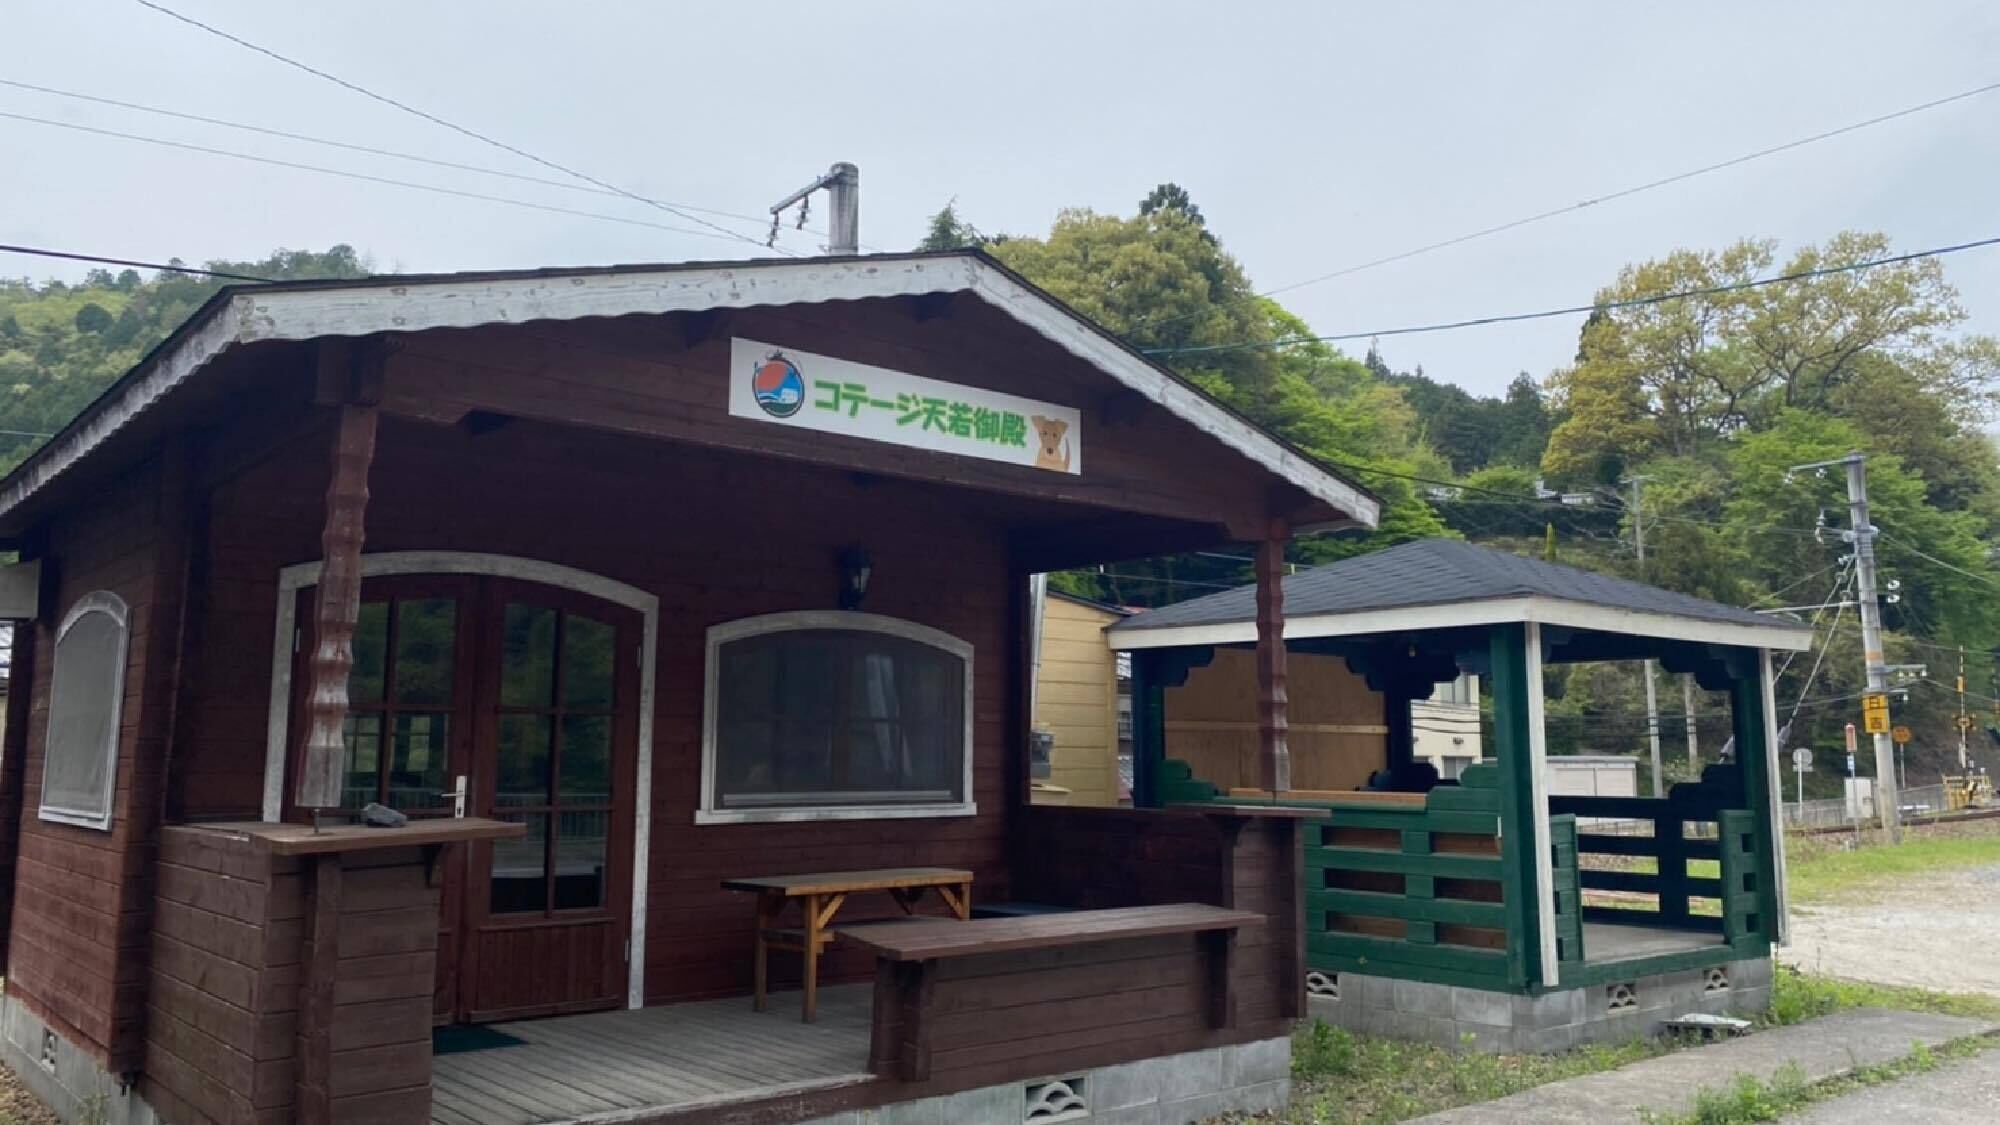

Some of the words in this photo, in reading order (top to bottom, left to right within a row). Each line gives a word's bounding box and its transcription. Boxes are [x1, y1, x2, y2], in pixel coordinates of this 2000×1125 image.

[814, 379, 1027, 447] コテージ天若御殿
